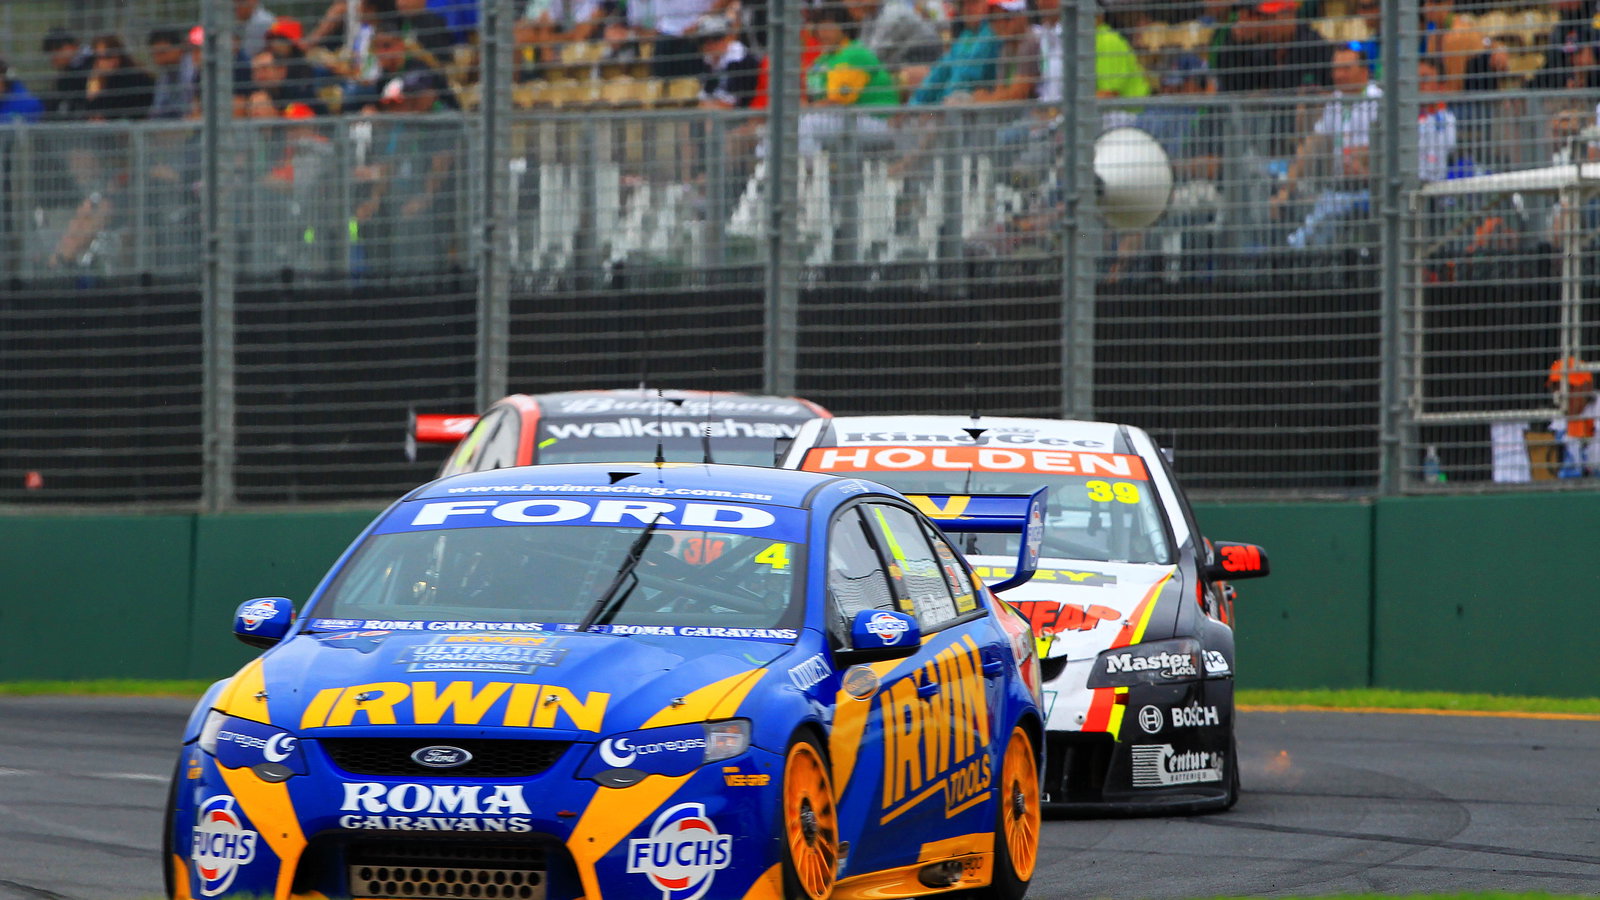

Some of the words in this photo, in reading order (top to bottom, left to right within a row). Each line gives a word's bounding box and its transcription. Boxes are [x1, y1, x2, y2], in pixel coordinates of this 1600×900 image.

[819, 448, 1132, 476] HOLDEN
[447, 484, 773, 500] www.irwinracing.com.au
[1085, 480, 1141, 504] 39
[411, 499, 776, 529] FORD
[754, 542, 790, 570] 4
[1221, 545, 1261, 572] 3M
[361, 619, 424, 631] ROMA
[427, 621, 544, 632] CARAVANS
[610, 624, 676, 636] ROMA
[679, 626, 799, 639] CARAVANS
[866, 619, 909, 633] FUCHS
[412, 645, 554, 657] ULTIMATE
[412, 654, 551, 665] TRADESMAN
[422, 663, 523, 671] CHALLENGE
[1106, 652, 1192, 674] Master
[1171, 664, 1197, 676] Lock
[300, 681, 611, 733] IRWIN
[1171, 705, 1220, 728] BOSCH
[880, 634, 989, 810] IRWIN
[422, 748, 461, 764] Ford
[635, 736, 706, 755] coregas
[949, 753, 992, 805] TOOLS
[340, 782, 532, 814] ROMA
[339, 814, 533, 833] CARAVANS
[192, 831, 253, 860] FUCHS
[632, 839, 728, 867] FUCHS
